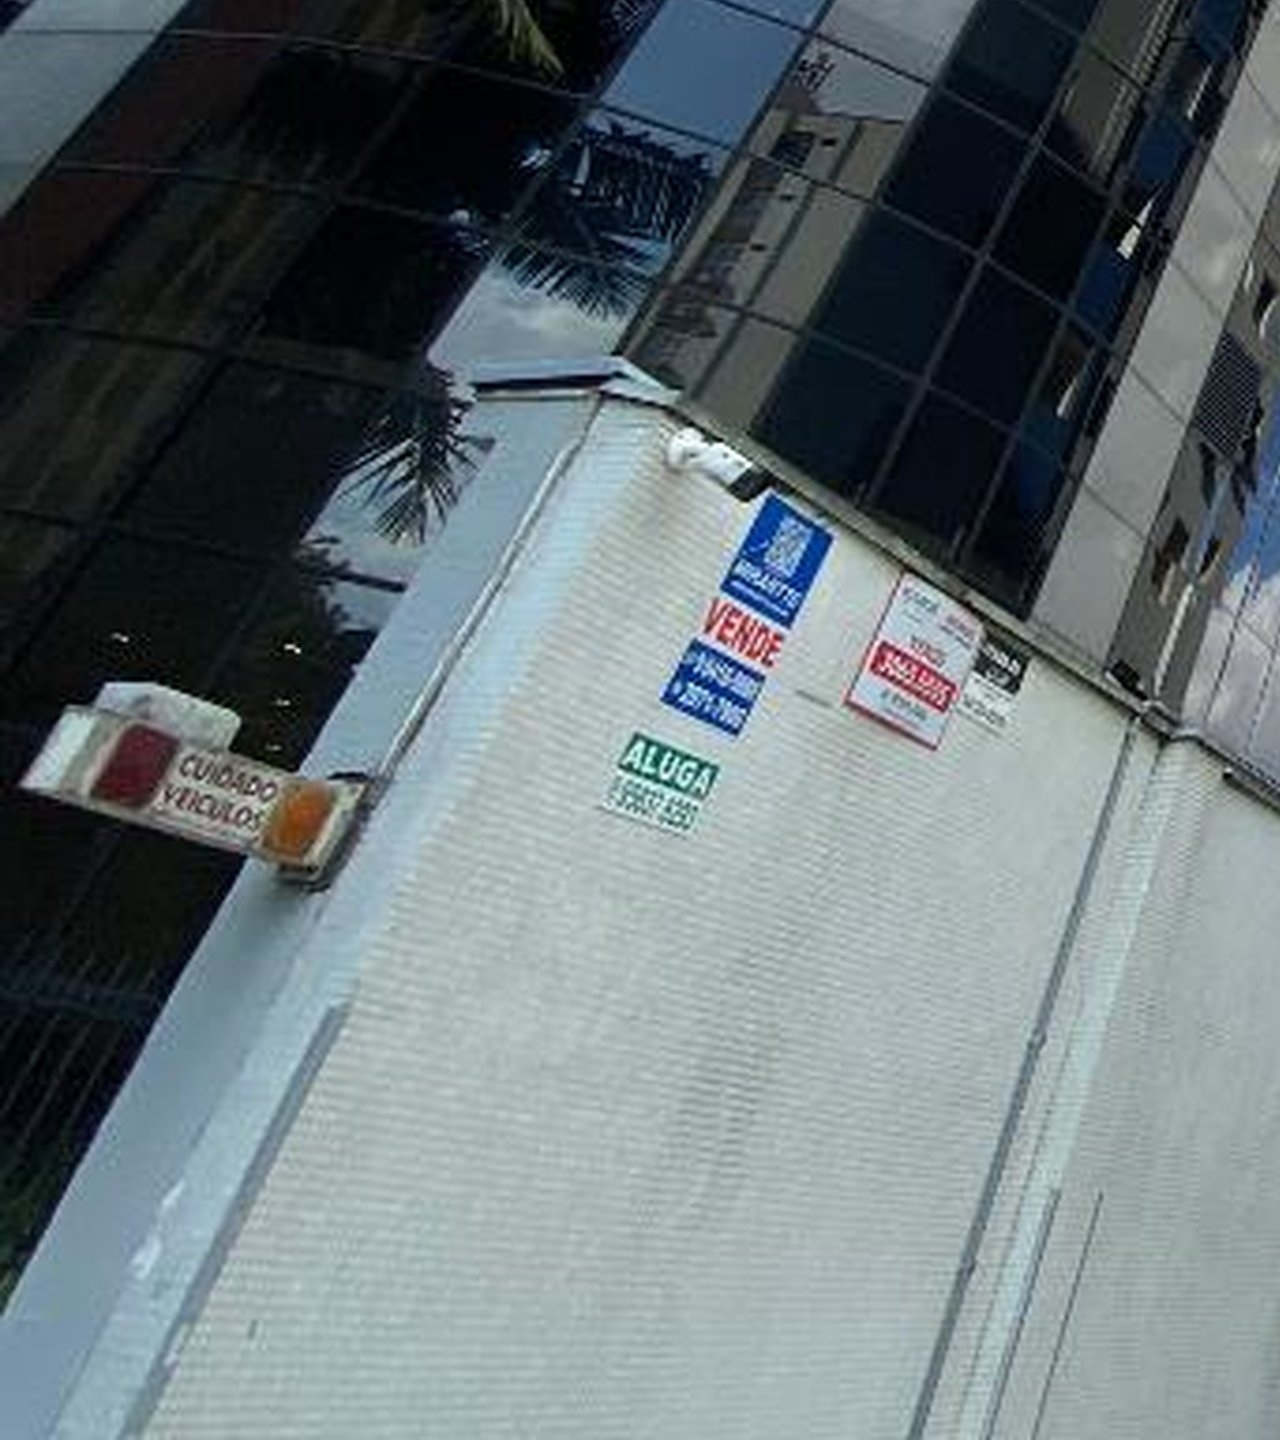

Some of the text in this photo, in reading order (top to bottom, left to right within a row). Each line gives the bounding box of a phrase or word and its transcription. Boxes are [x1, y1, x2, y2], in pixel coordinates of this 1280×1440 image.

[703, 597, 785, 668] VENDE
[179, 753, 279, 803] CUIDADO
[620, 740, 712, 796] ALUGA
